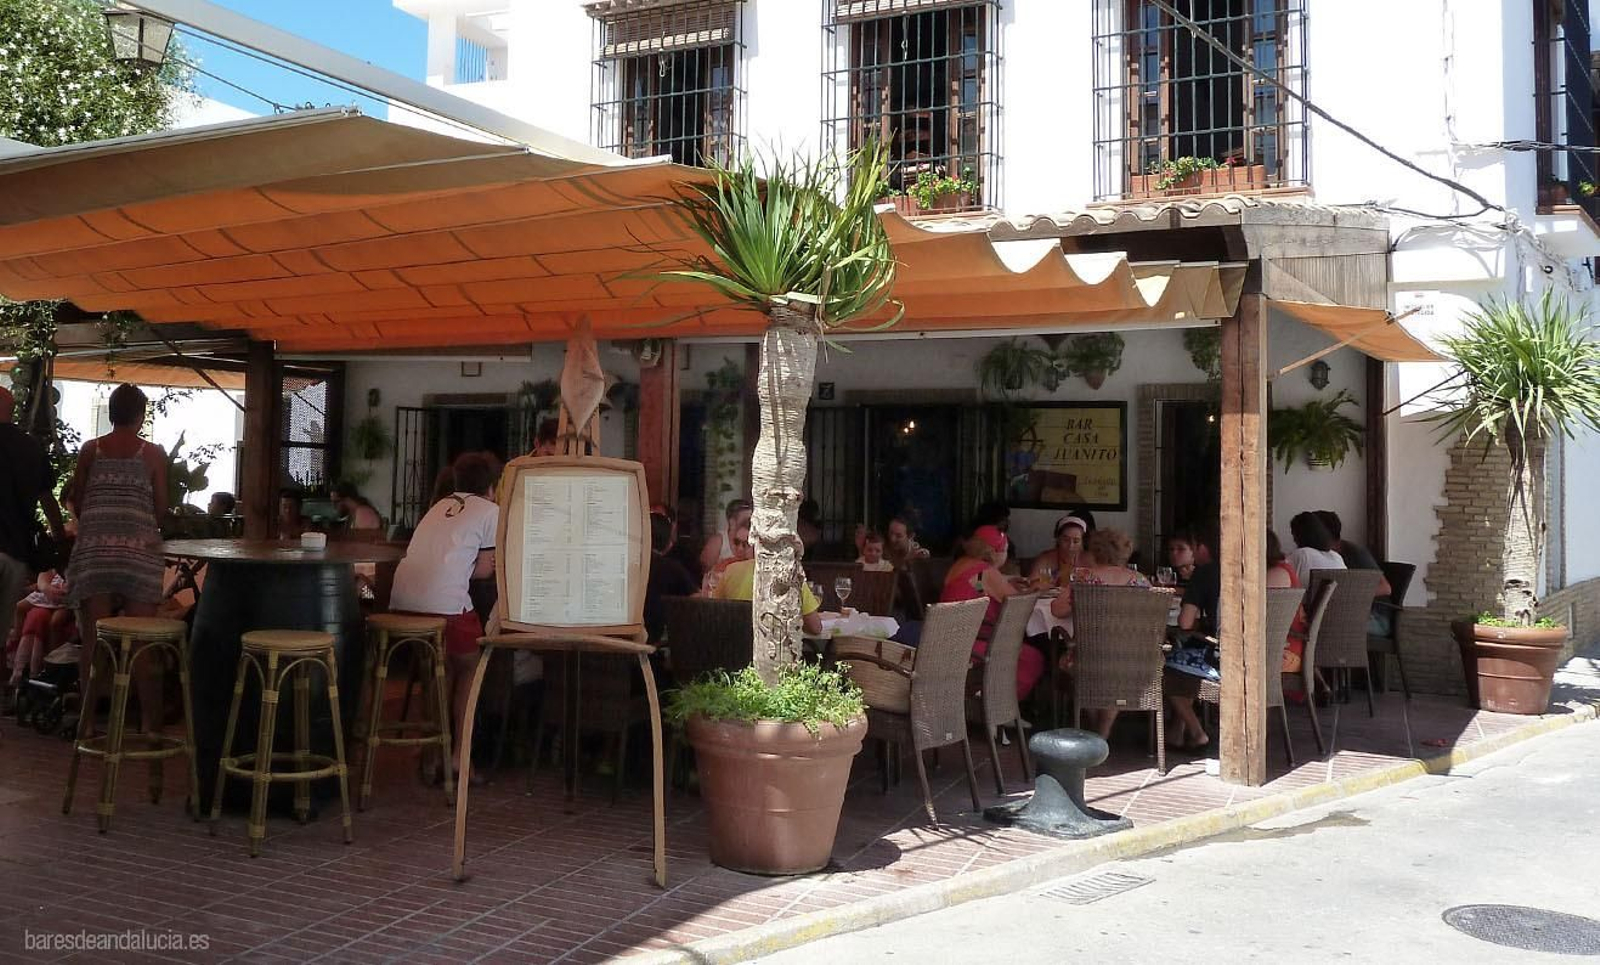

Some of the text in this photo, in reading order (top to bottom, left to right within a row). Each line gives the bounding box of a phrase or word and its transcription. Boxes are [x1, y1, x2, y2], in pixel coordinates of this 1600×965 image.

[1067, 418, 1093, 430] BAR
[1063, 433, 1098, 444] CASA
[1053, 447, 1117, 460] JUANITO
